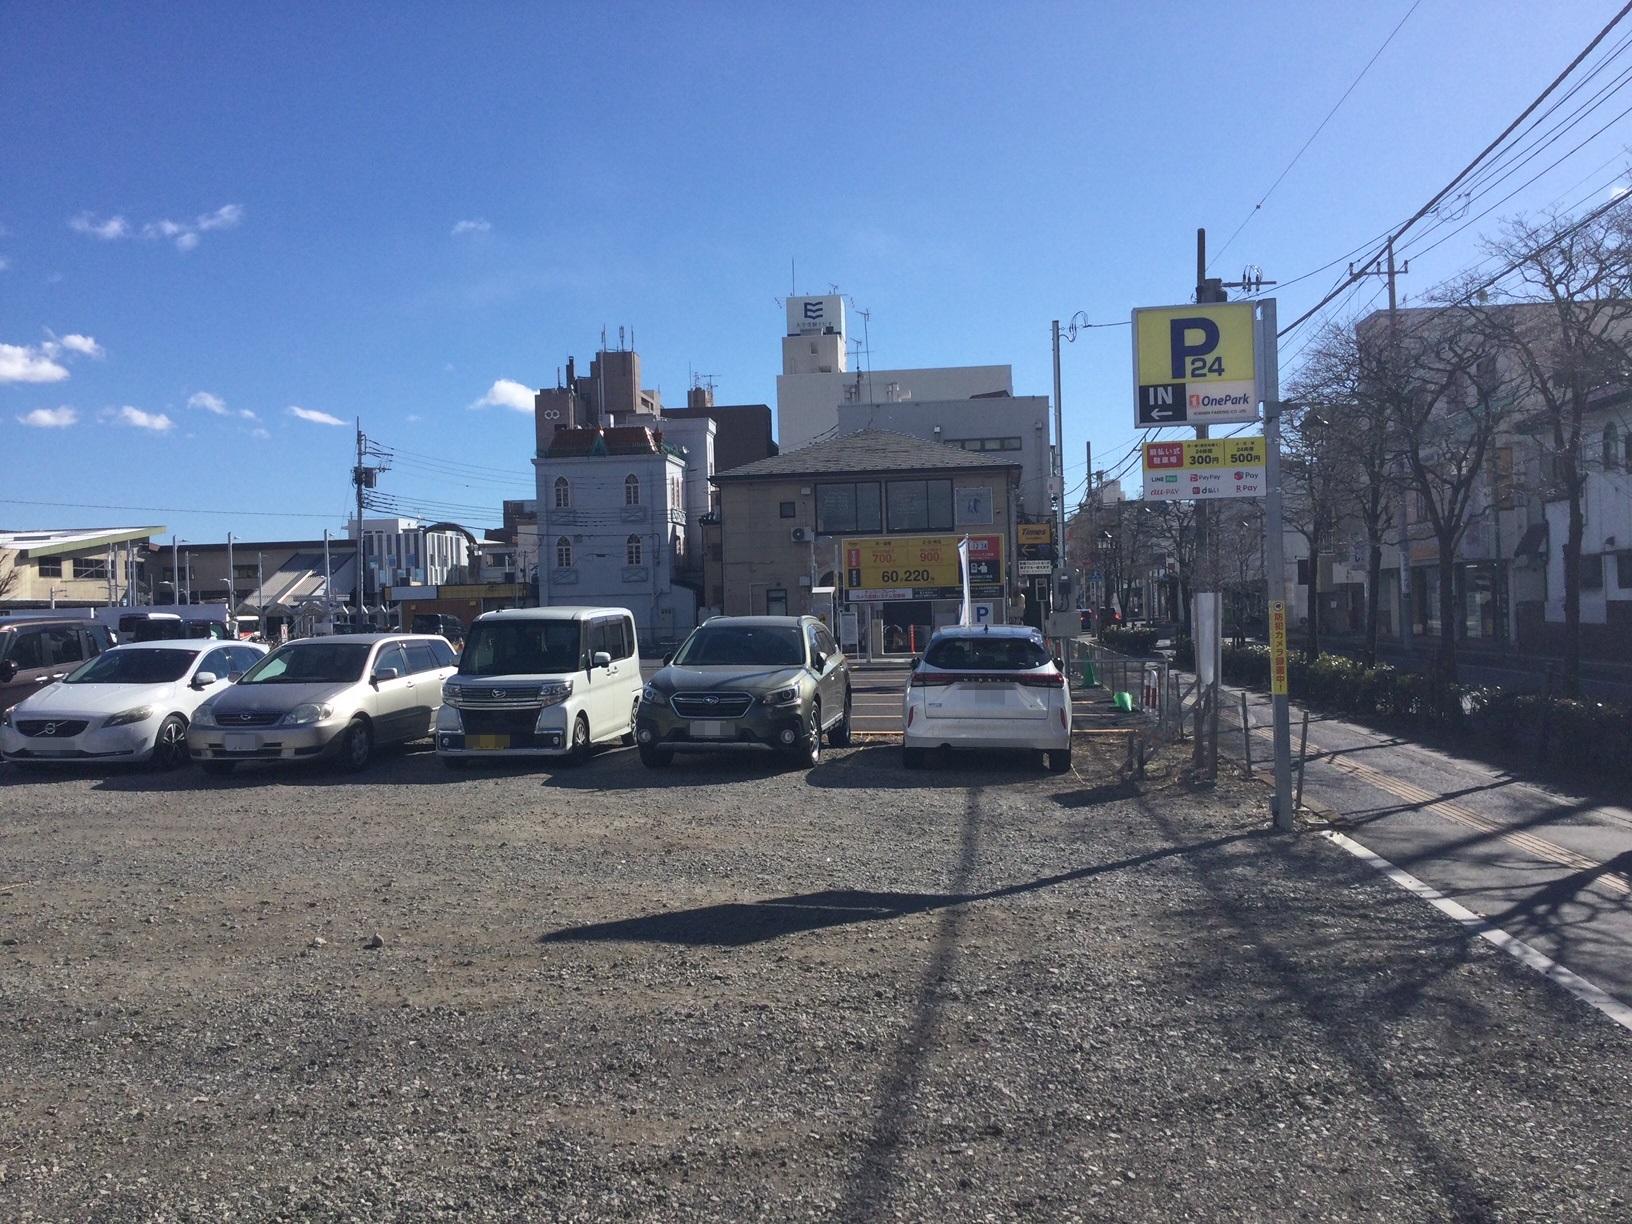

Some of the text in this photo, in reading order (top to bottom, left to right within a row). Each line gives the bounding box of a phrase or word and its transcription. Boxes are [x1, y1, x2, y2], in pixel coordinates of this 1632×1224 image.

[1170, 317, 1220, 379] P
[1191, 356, 1224, 378] 24
[1149, 386, 1173, 405] IN
[1201, 394, 1249, 406] OnePark
[1190, 455, 1219, 465] 300円
[1231, 453, 1260, 463] 500円
[1245, 471, 1259, 480] Pay
[976, 607, 989, 623] P
